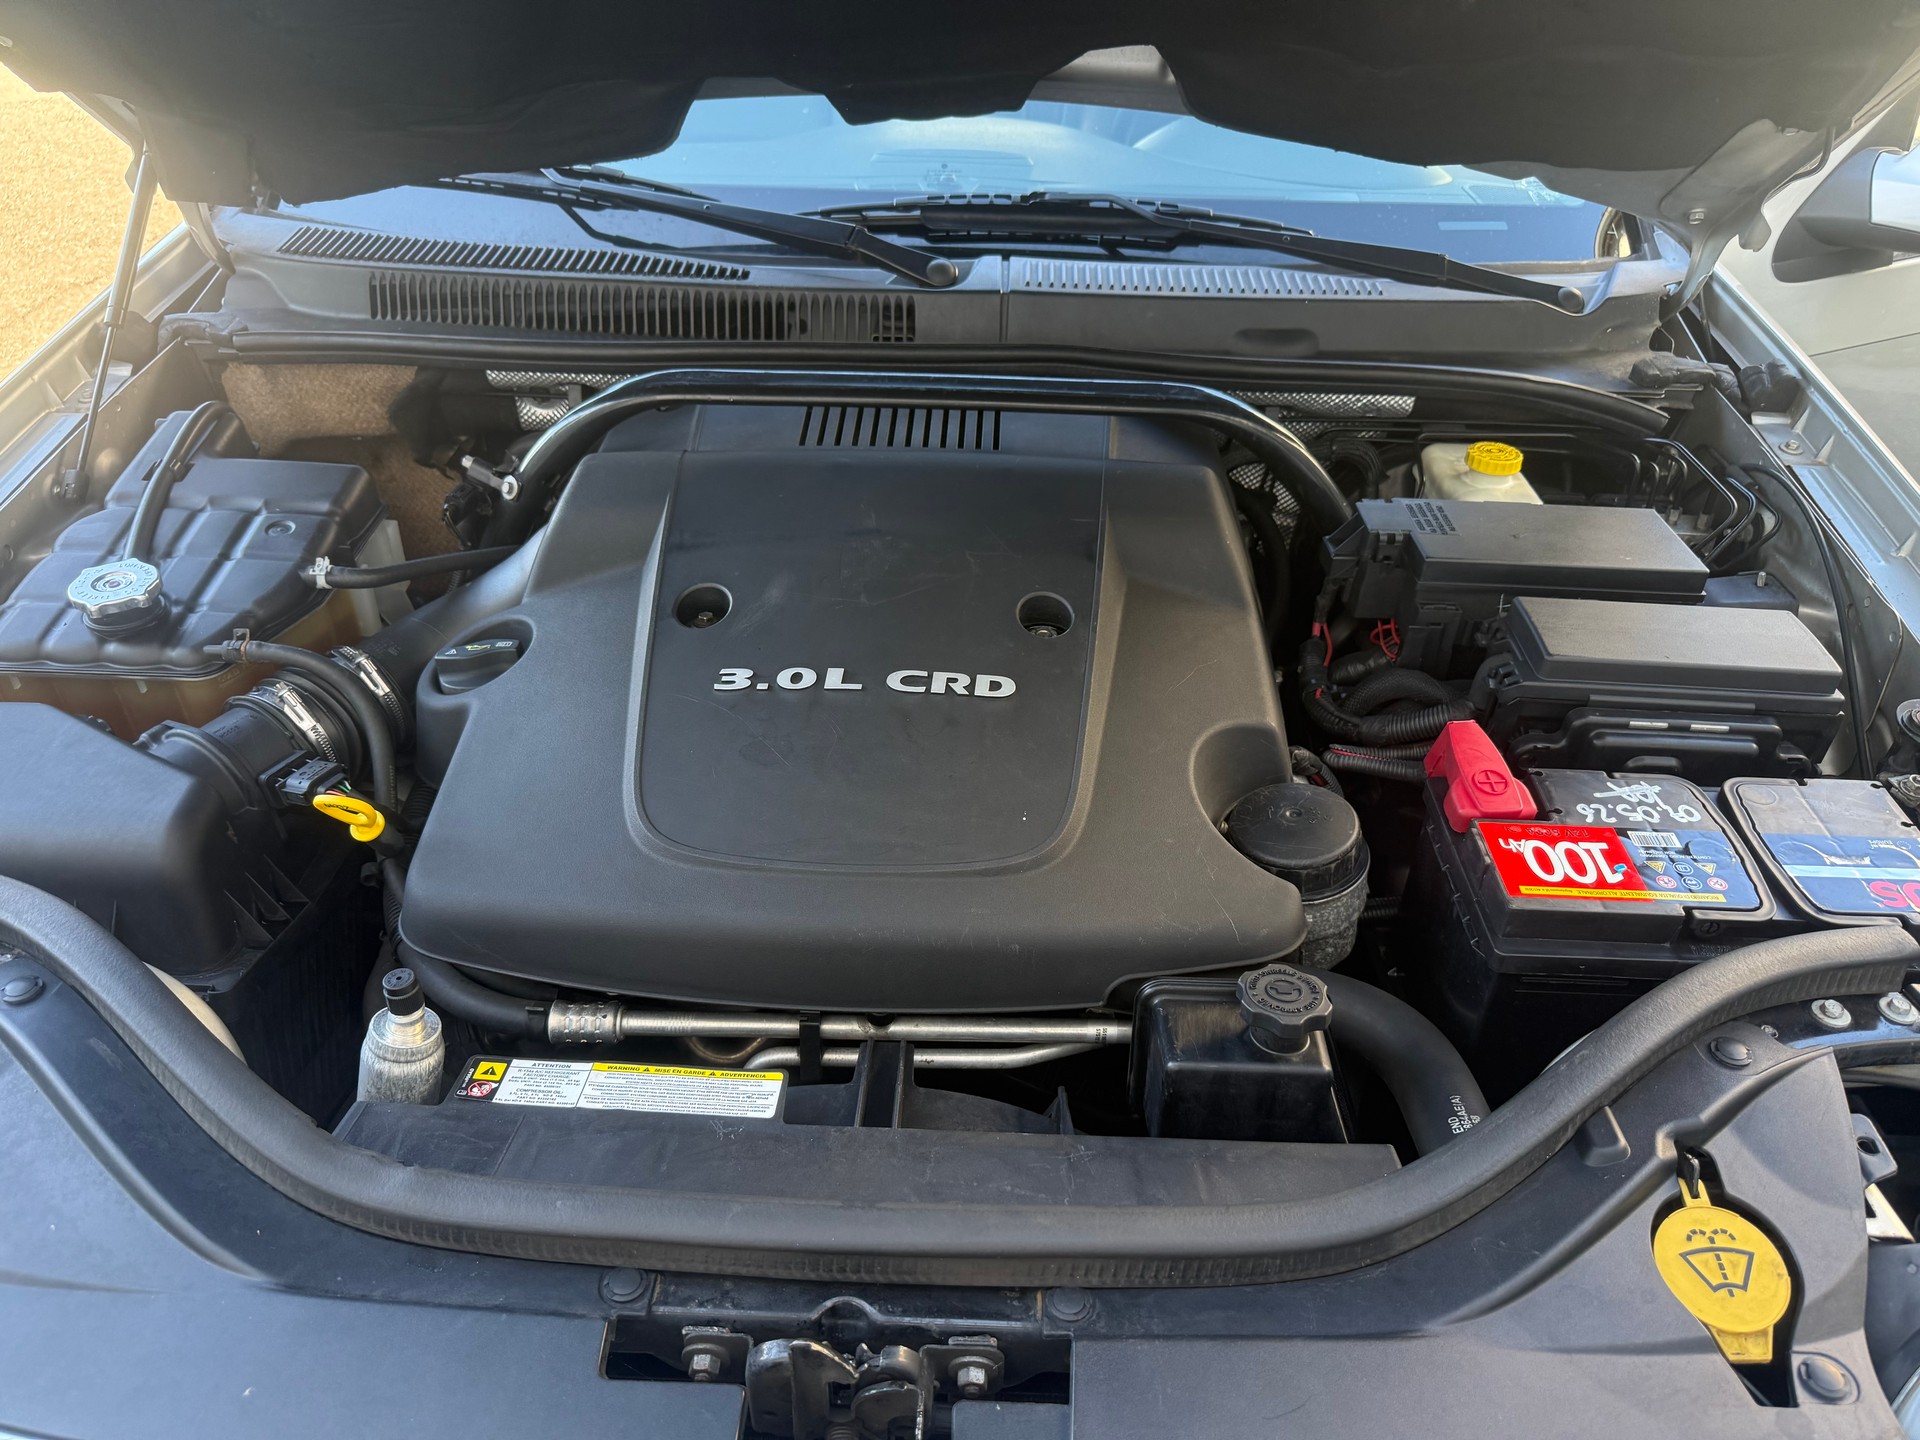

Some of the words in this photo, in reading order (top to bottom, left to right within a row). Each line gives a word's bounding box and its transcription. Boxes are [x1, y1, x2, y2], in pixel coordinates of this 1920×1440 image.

[713, 667, 863, 691] 3.0L
[885, 669, 1017, 698] CRD
[720, 1071, 767, 1079] ADVERTENCIA
[1448, 1116, 1464, 1134] END
